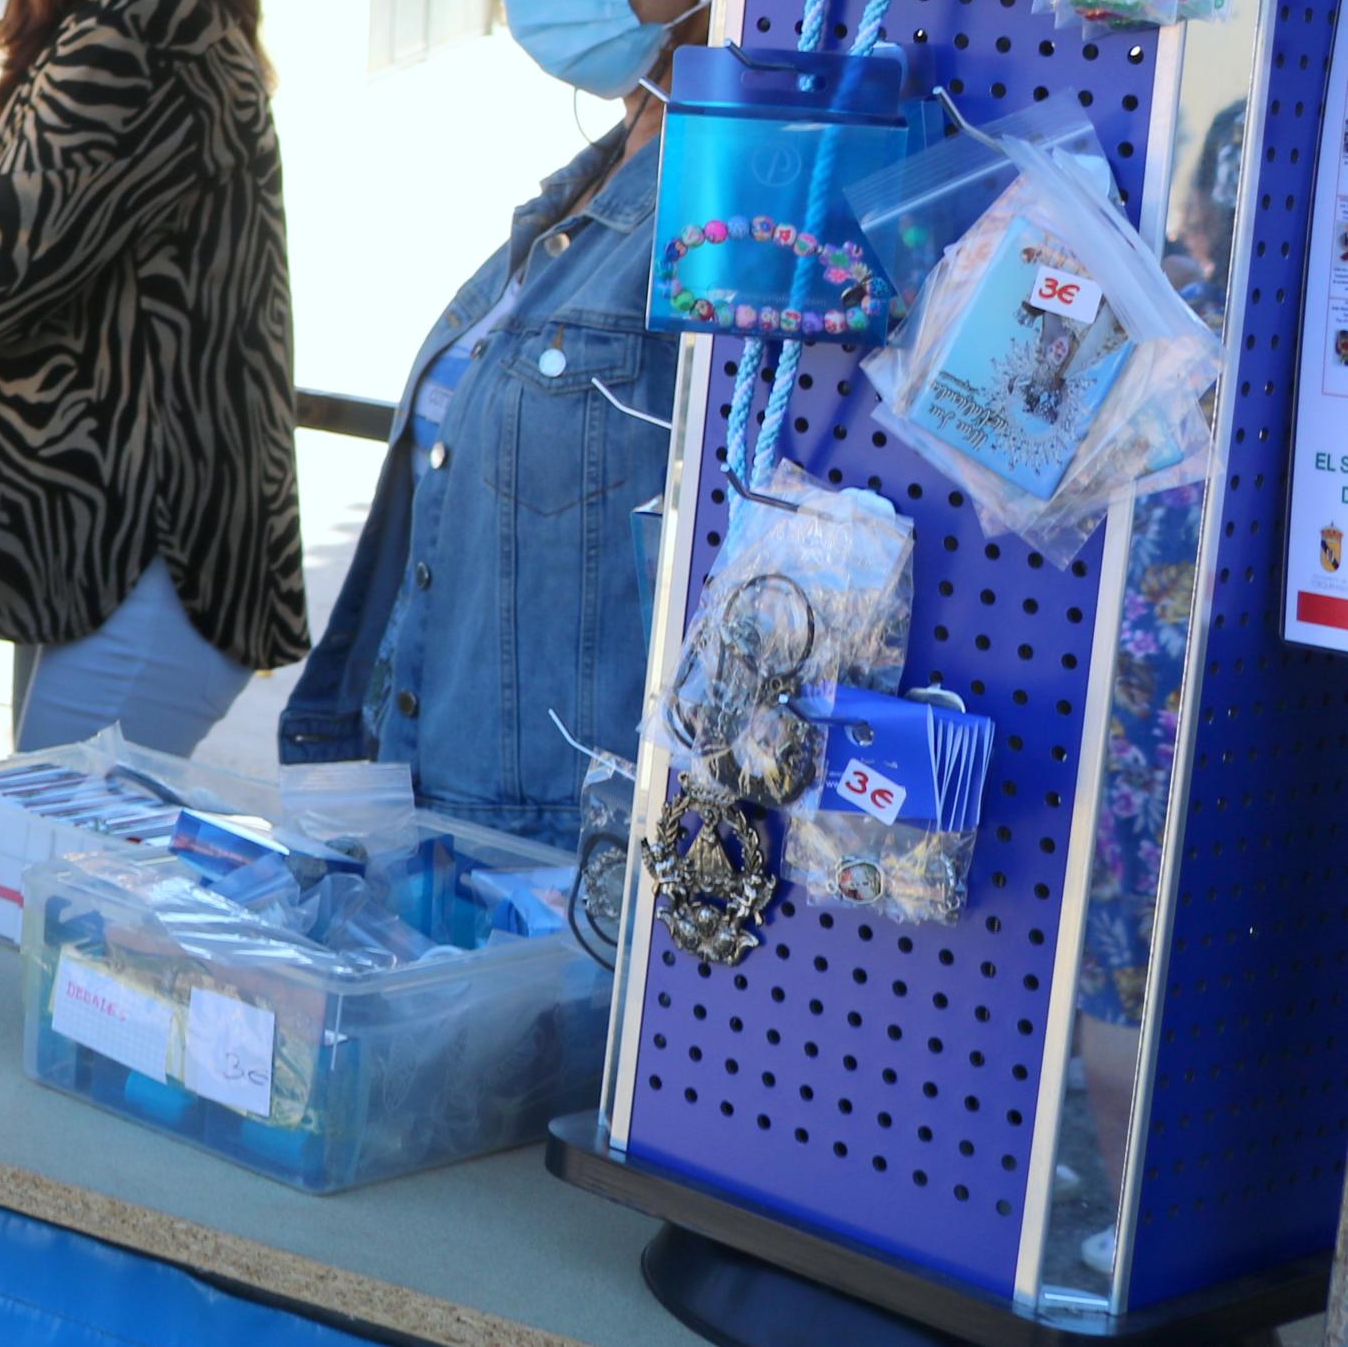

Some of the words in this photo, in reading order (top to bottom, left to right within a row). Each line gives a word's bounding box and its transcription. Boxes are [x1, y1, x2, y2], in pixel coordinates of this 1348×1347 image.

[1038, 277, 1081, 305] 3€
[1315, 451, 1336, 472] EL
[845, 770, 894, 810] 3€
